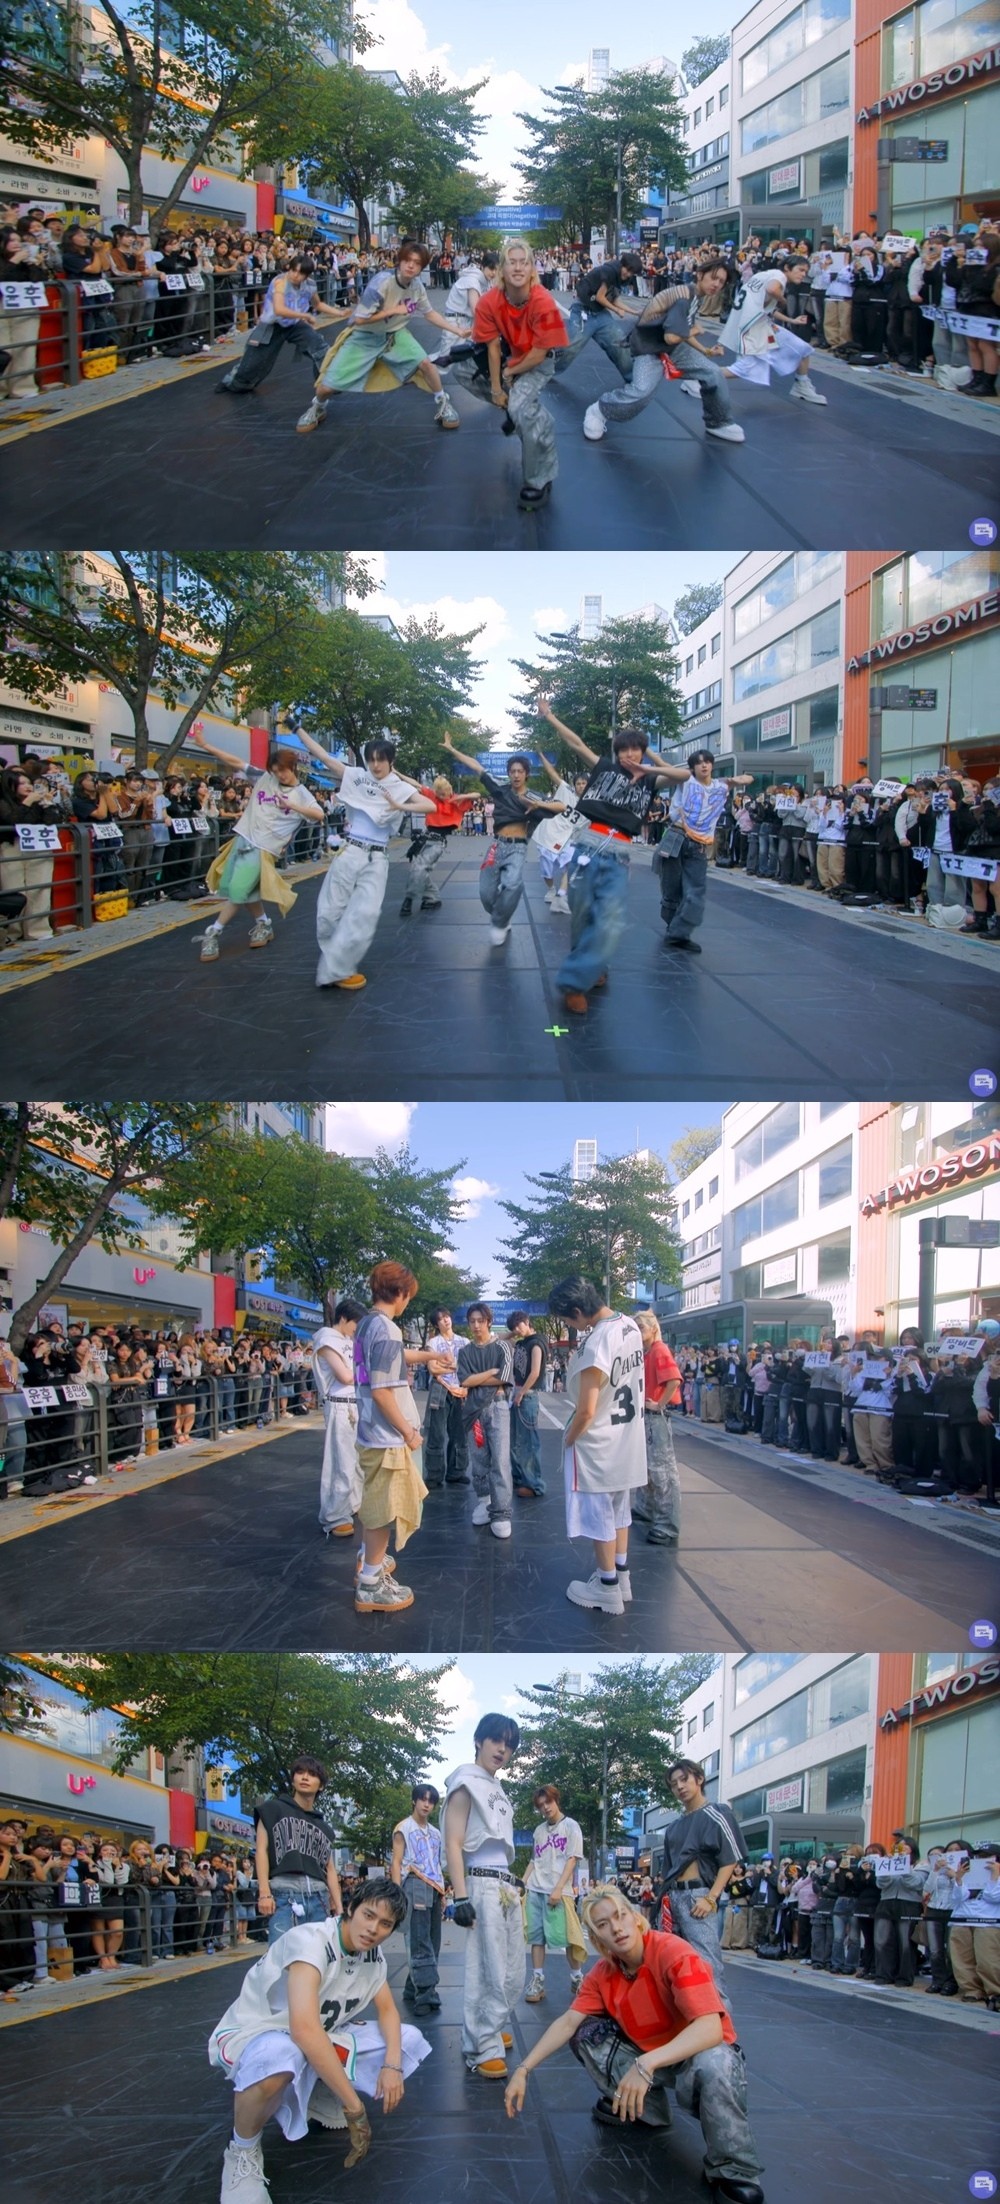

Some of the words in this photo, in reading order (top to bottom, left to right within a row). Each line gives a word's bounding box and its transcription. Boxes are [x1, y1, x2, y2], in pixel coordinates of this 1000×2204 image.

[857, 107, 869, 122] A
[191, 176, 211, 193] U+
[5, 285, 41, 307] 윤후
[848, 656, 859, 671] A
[863, 593, 998, 664] TWOSOME
[4, 724, 22, 733] 라멘
[561, 805, 580, 824] 33
[20, 827, 55, 849] 윤후
[861, 1194, 875, 1211] A
[133, 1267, 156, 1285] U+
[28, 1388, 52, 1405] 윤후
[65, 1384, 87, 1398] 홍민성
[881, 1709, 897, 1727] A
[67, 1773, 96, 1795] U+
[768, 1782, 799, 1807] 임대문의
[878, 1858, 906, 1871] 서현
